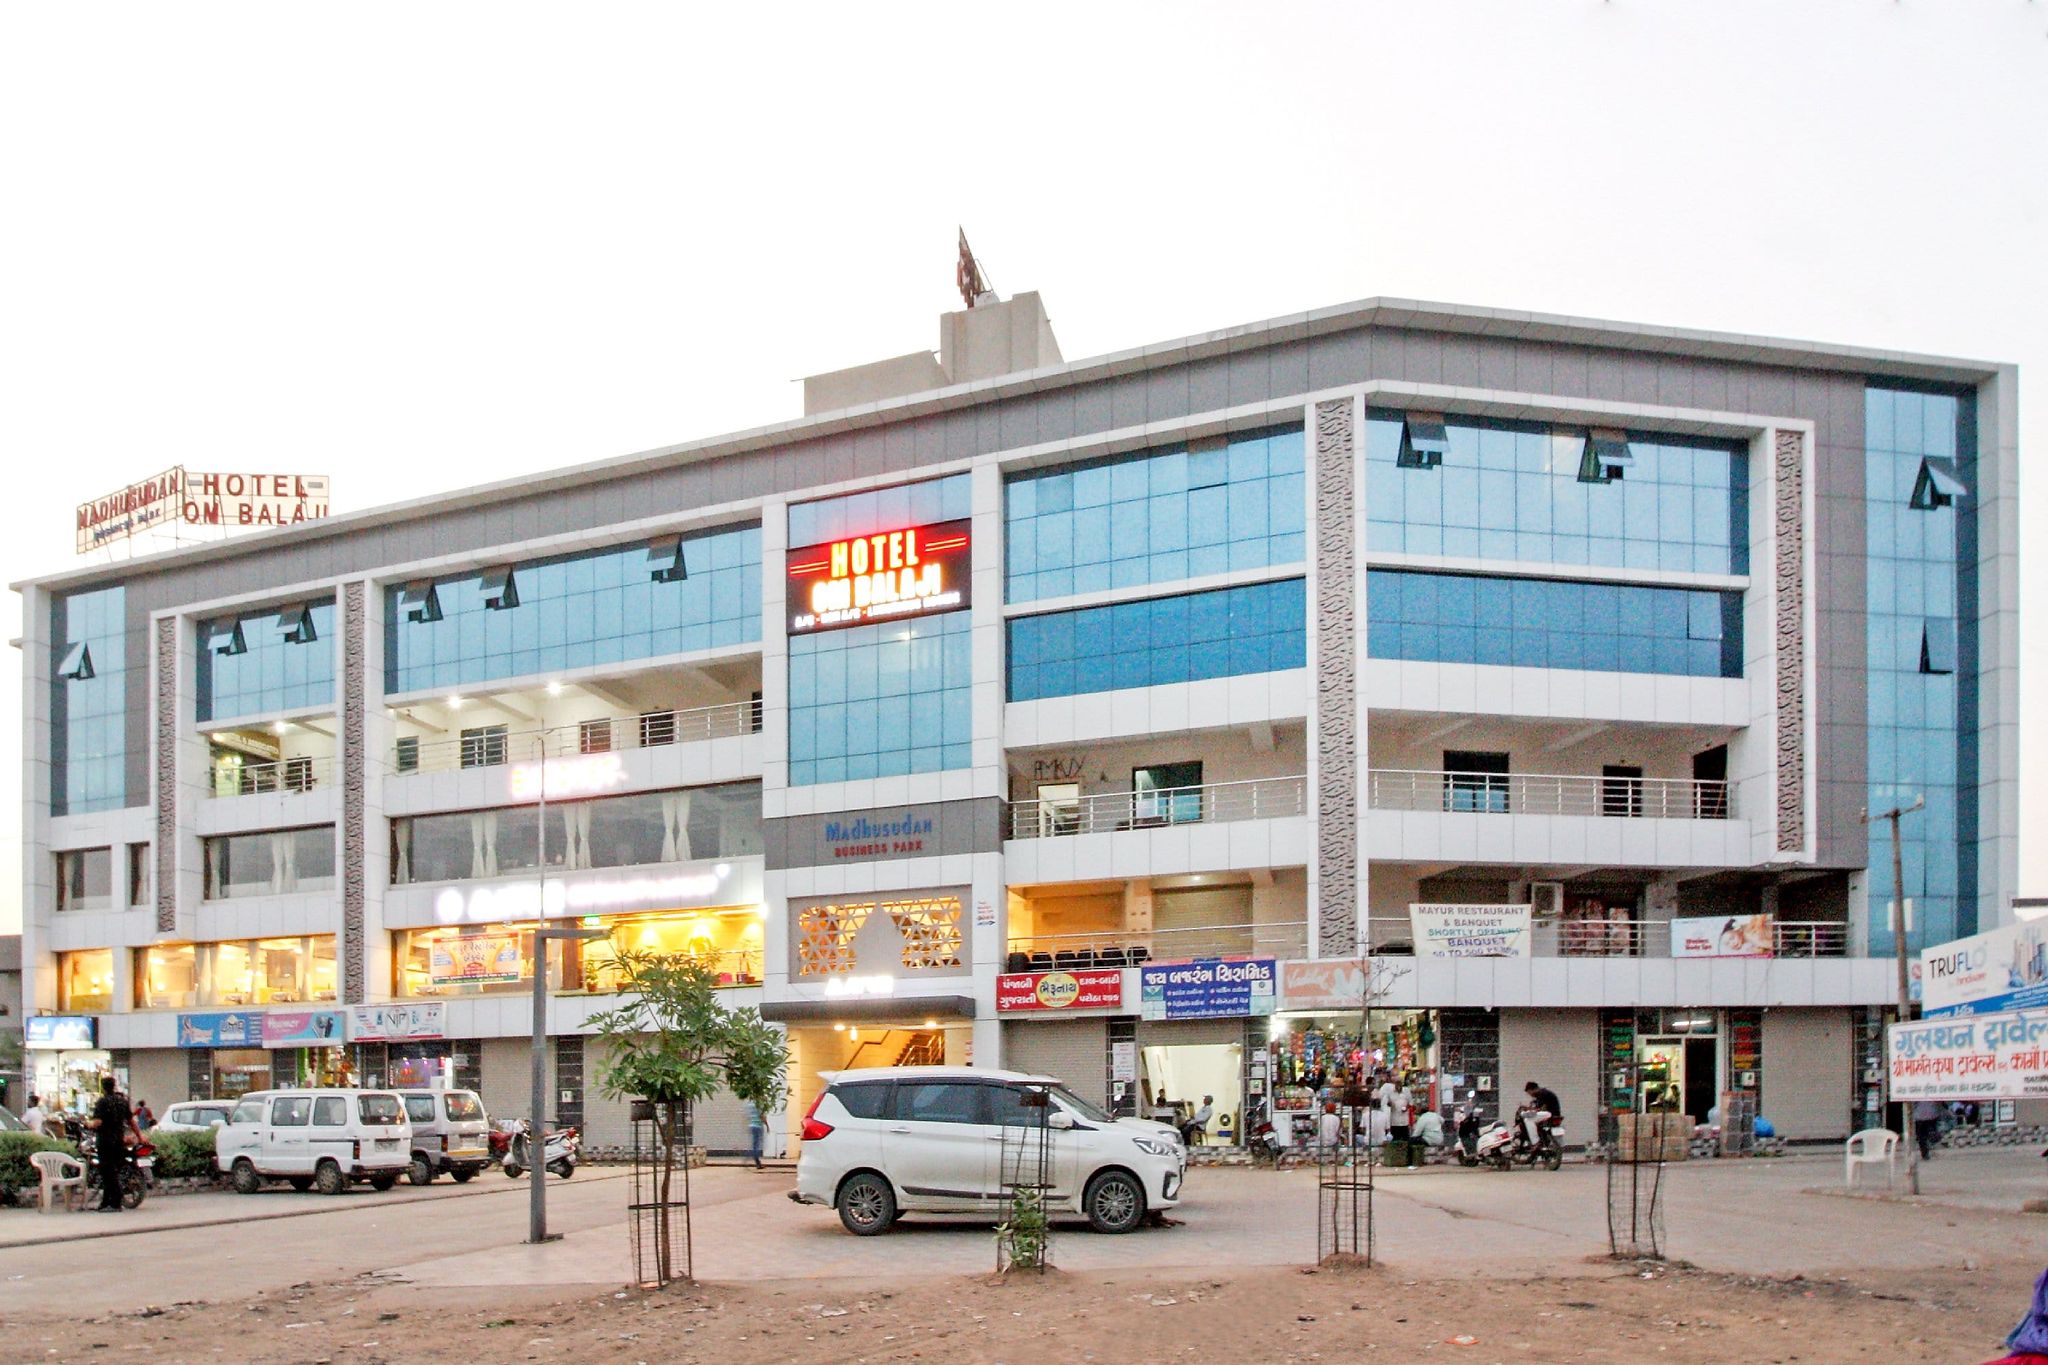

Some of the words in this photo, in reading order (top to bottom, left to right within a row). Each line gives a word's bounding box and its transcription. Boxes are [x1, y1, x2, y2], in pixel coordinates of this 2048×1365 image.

[203, 473, 308, 498] HOTEL
[79, 474, 177, 530] MADHUSUDAN
[831, 530, 919, 577] HOTEL
[834, 843, 888, 858] BUSINESS
[893, 840, 923, 853] PARK
[1418, 907, 1454, 915] MAYUR
[1458, 906, 1525, 915] RESTAURANT
[1454, 919, 1503, 927] BANQUET
[1428, 928, 1473, 937] SHORTLY
[1448, 937, 1507, 947] BANQUET
[1449, 949, 1463, 957] TO
[1895, 1024, 1976, 1058] गुलशन
